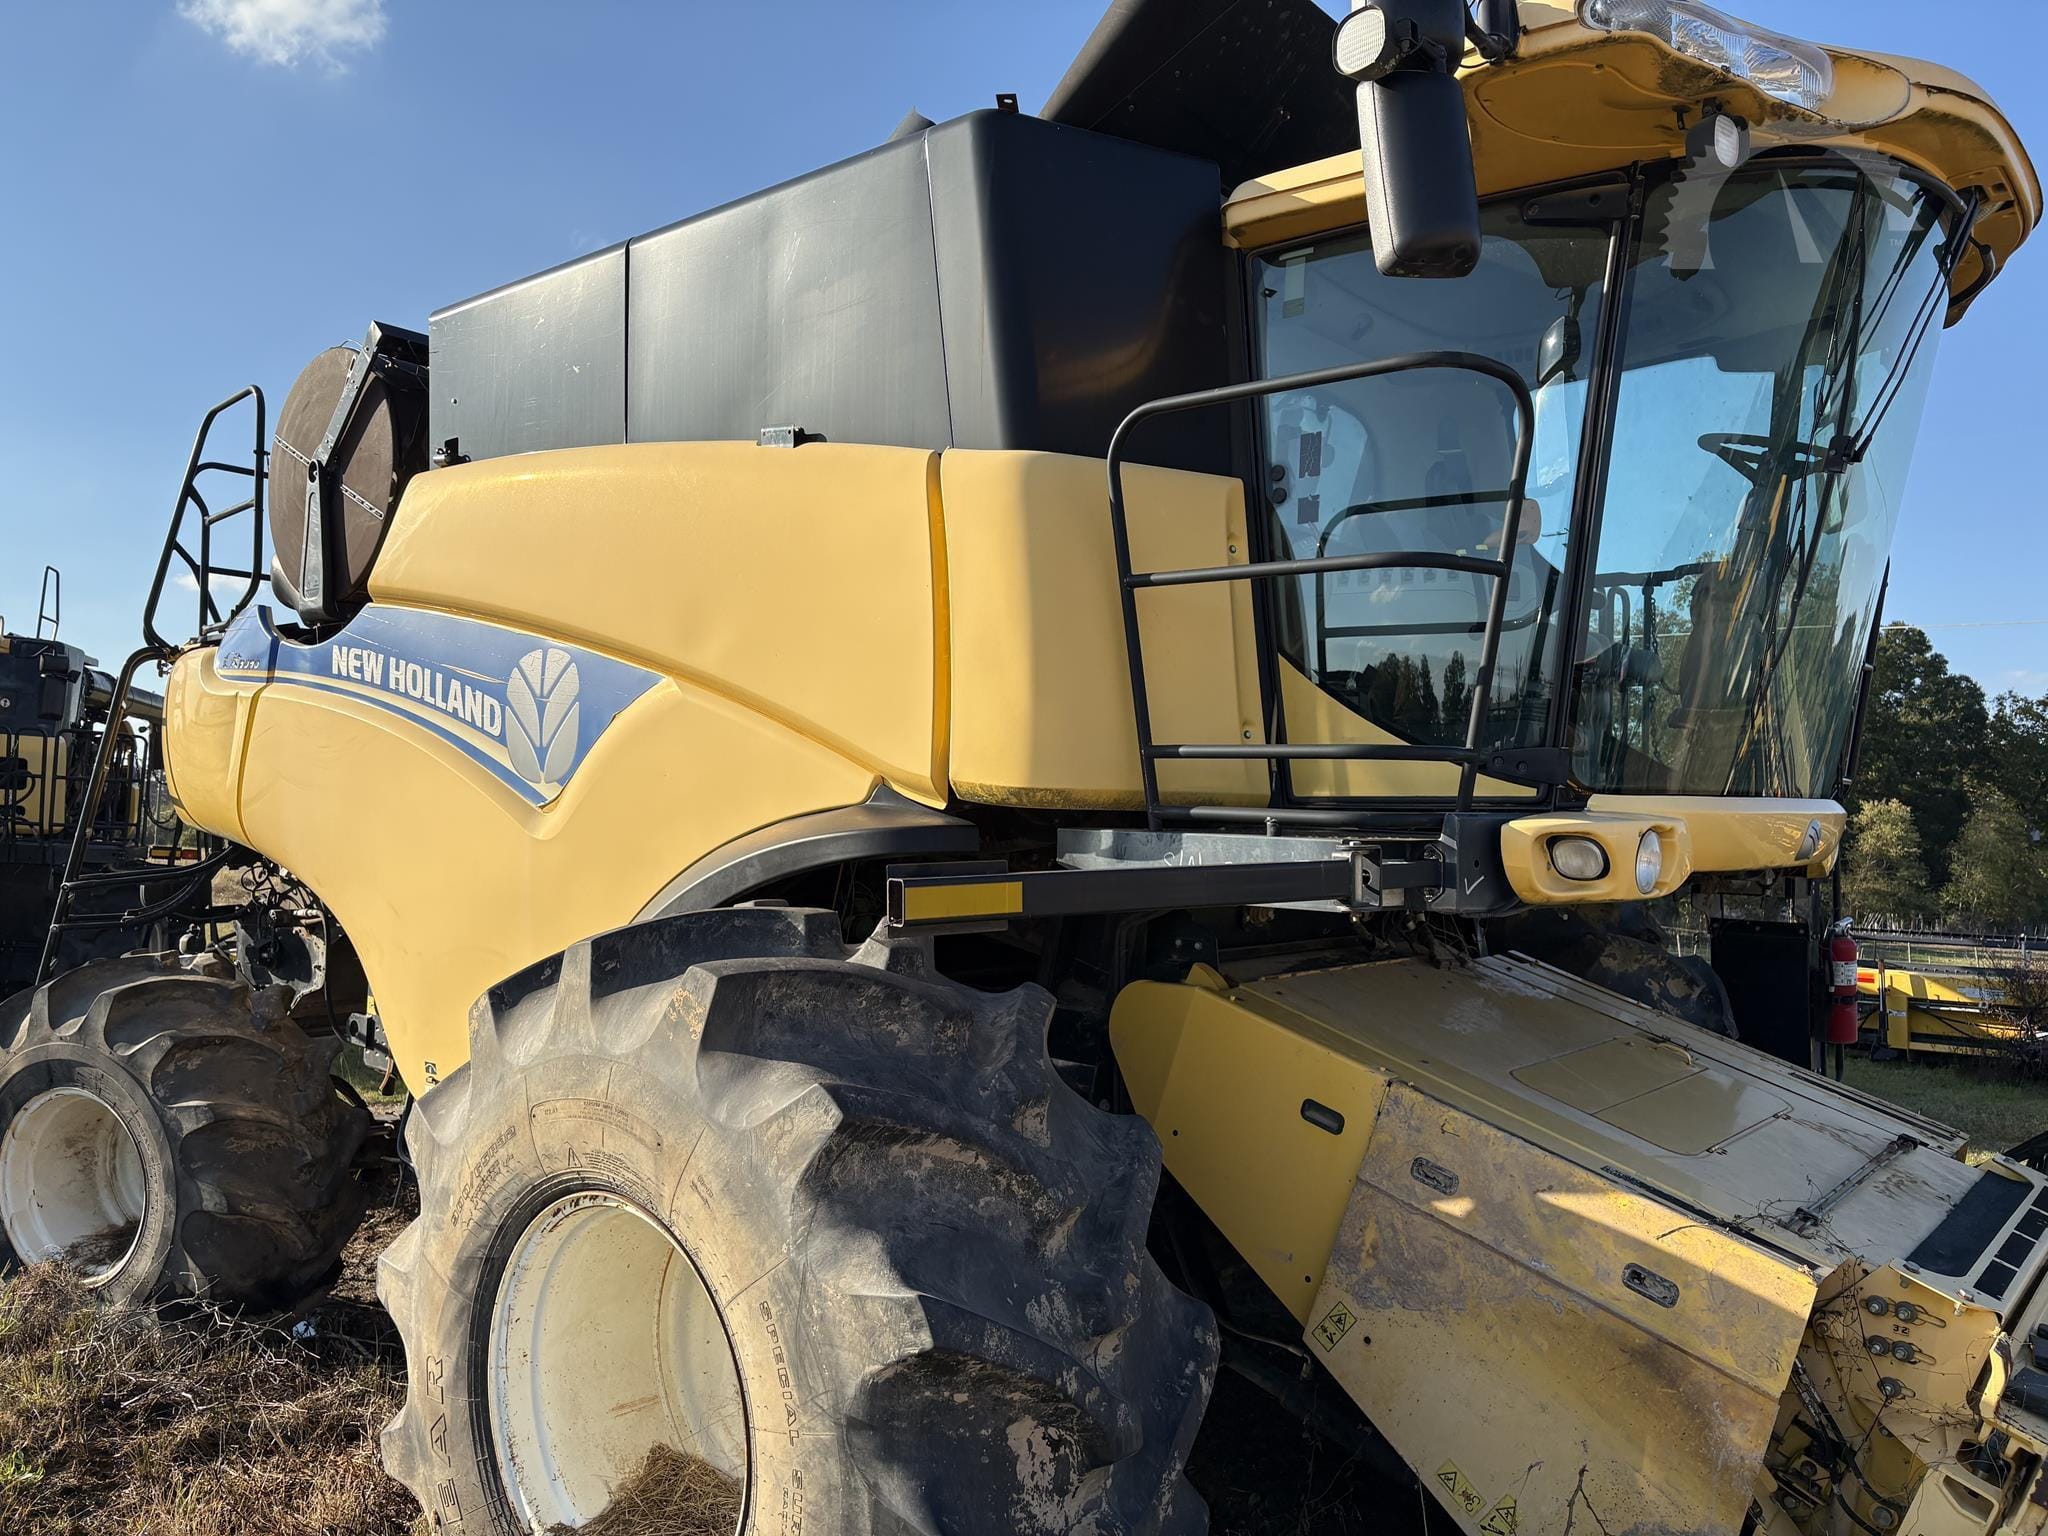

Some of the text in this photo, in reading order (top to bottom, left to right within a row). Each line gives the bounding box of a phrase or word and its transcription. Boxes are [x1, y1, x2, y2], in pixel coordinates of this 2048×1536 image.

[332, 645, 502, 737] NEW HOLLAND
[759, 1300, 800, 1447] SPECIAL
